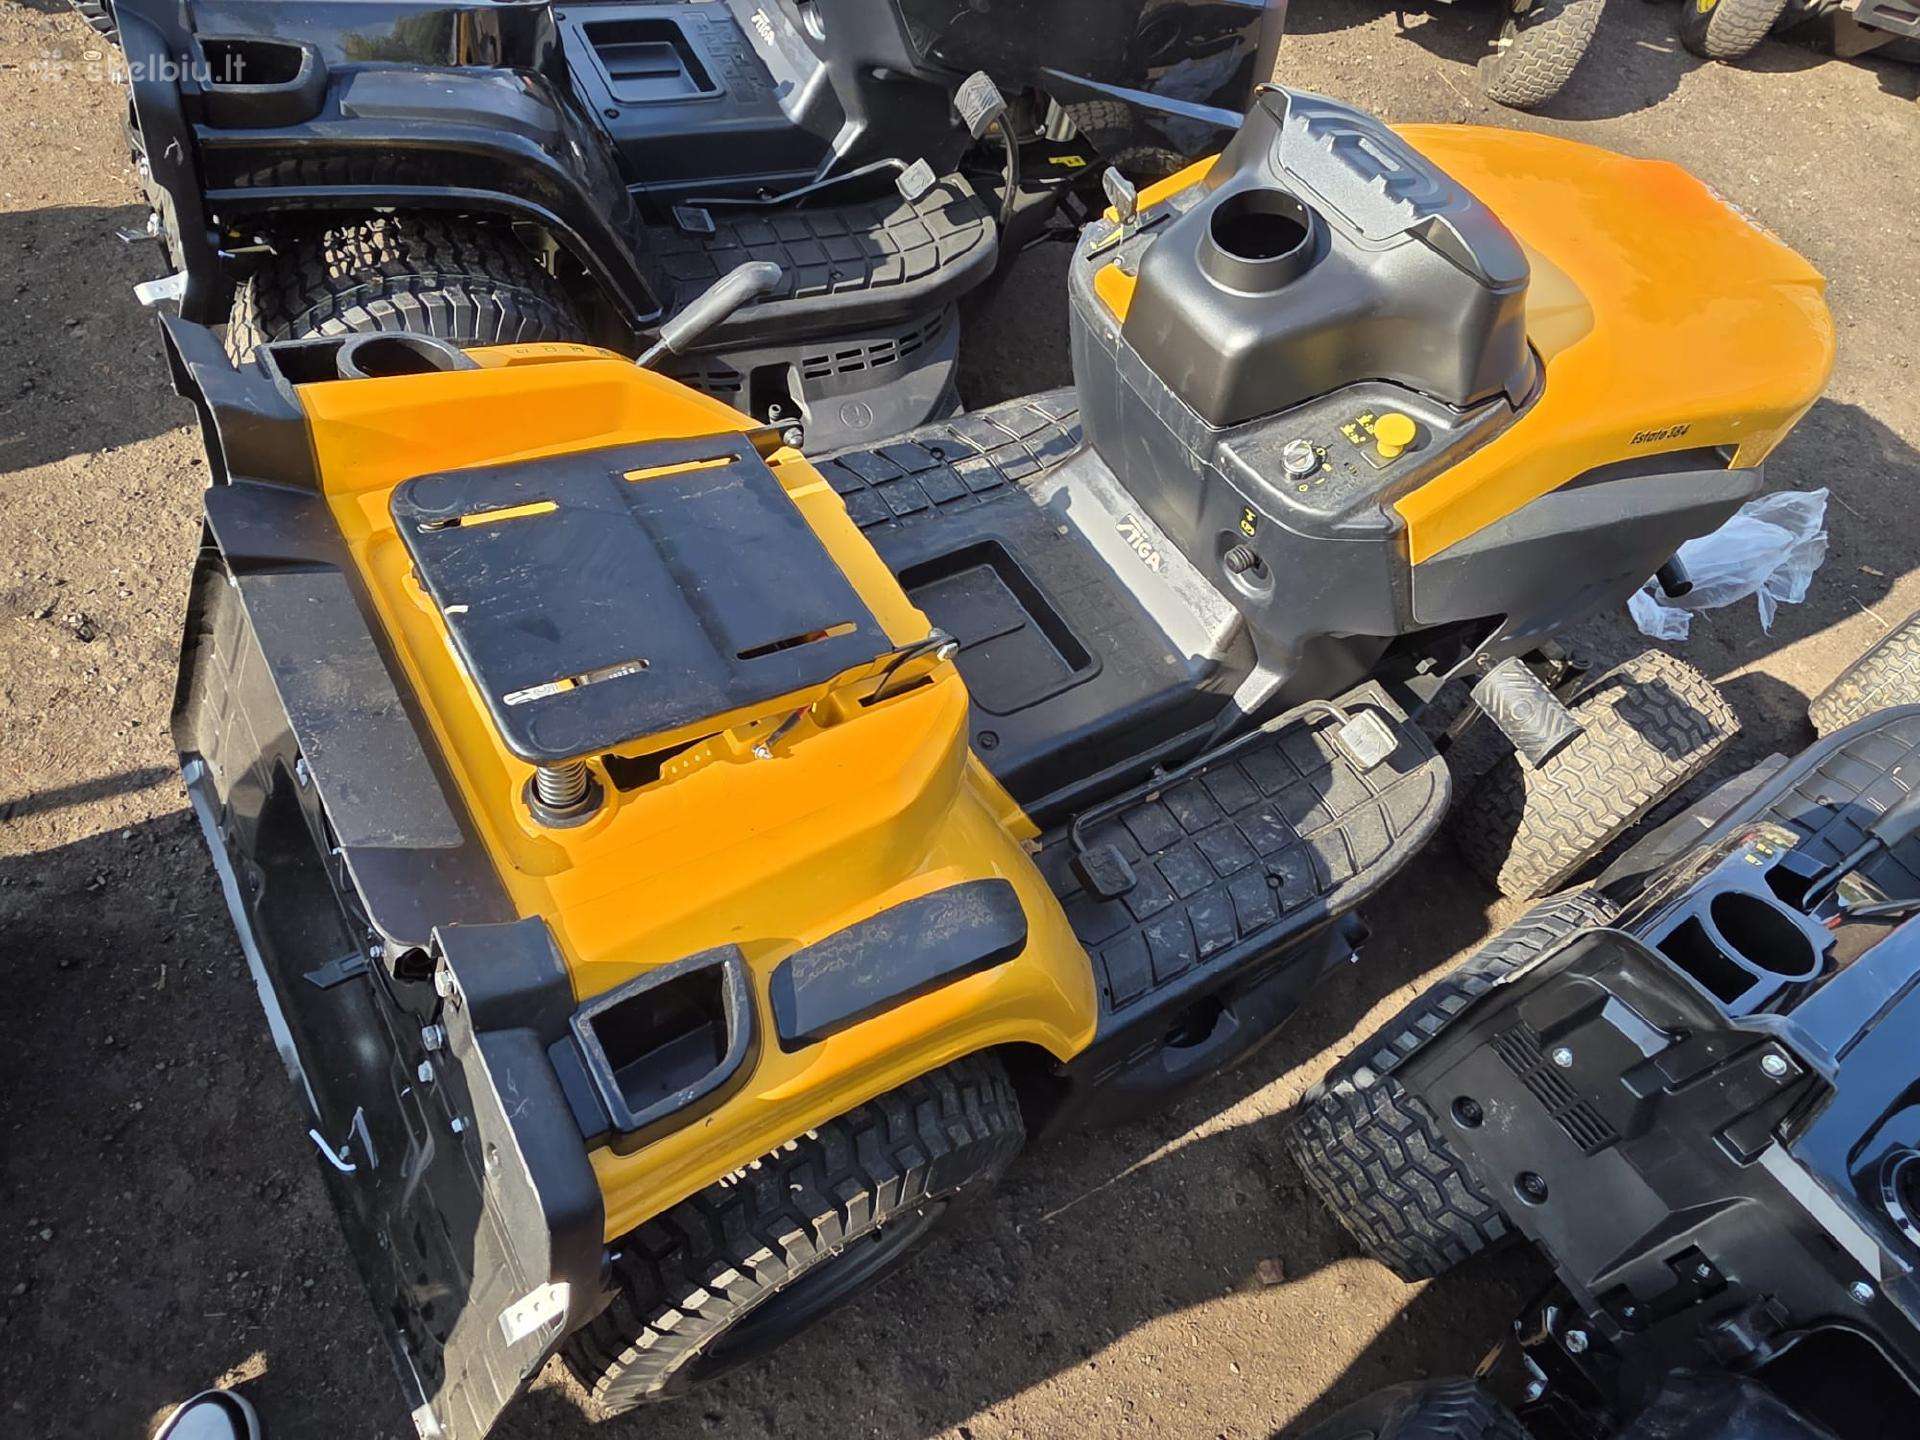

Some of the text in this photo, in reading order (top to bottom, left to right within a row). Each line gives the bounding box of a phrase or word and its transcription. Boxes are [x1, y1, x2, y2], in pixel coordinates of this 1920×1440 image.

[1629, 424, 1691, 445] Estate 384
[1115, 514, 1160, 572] STIGA
